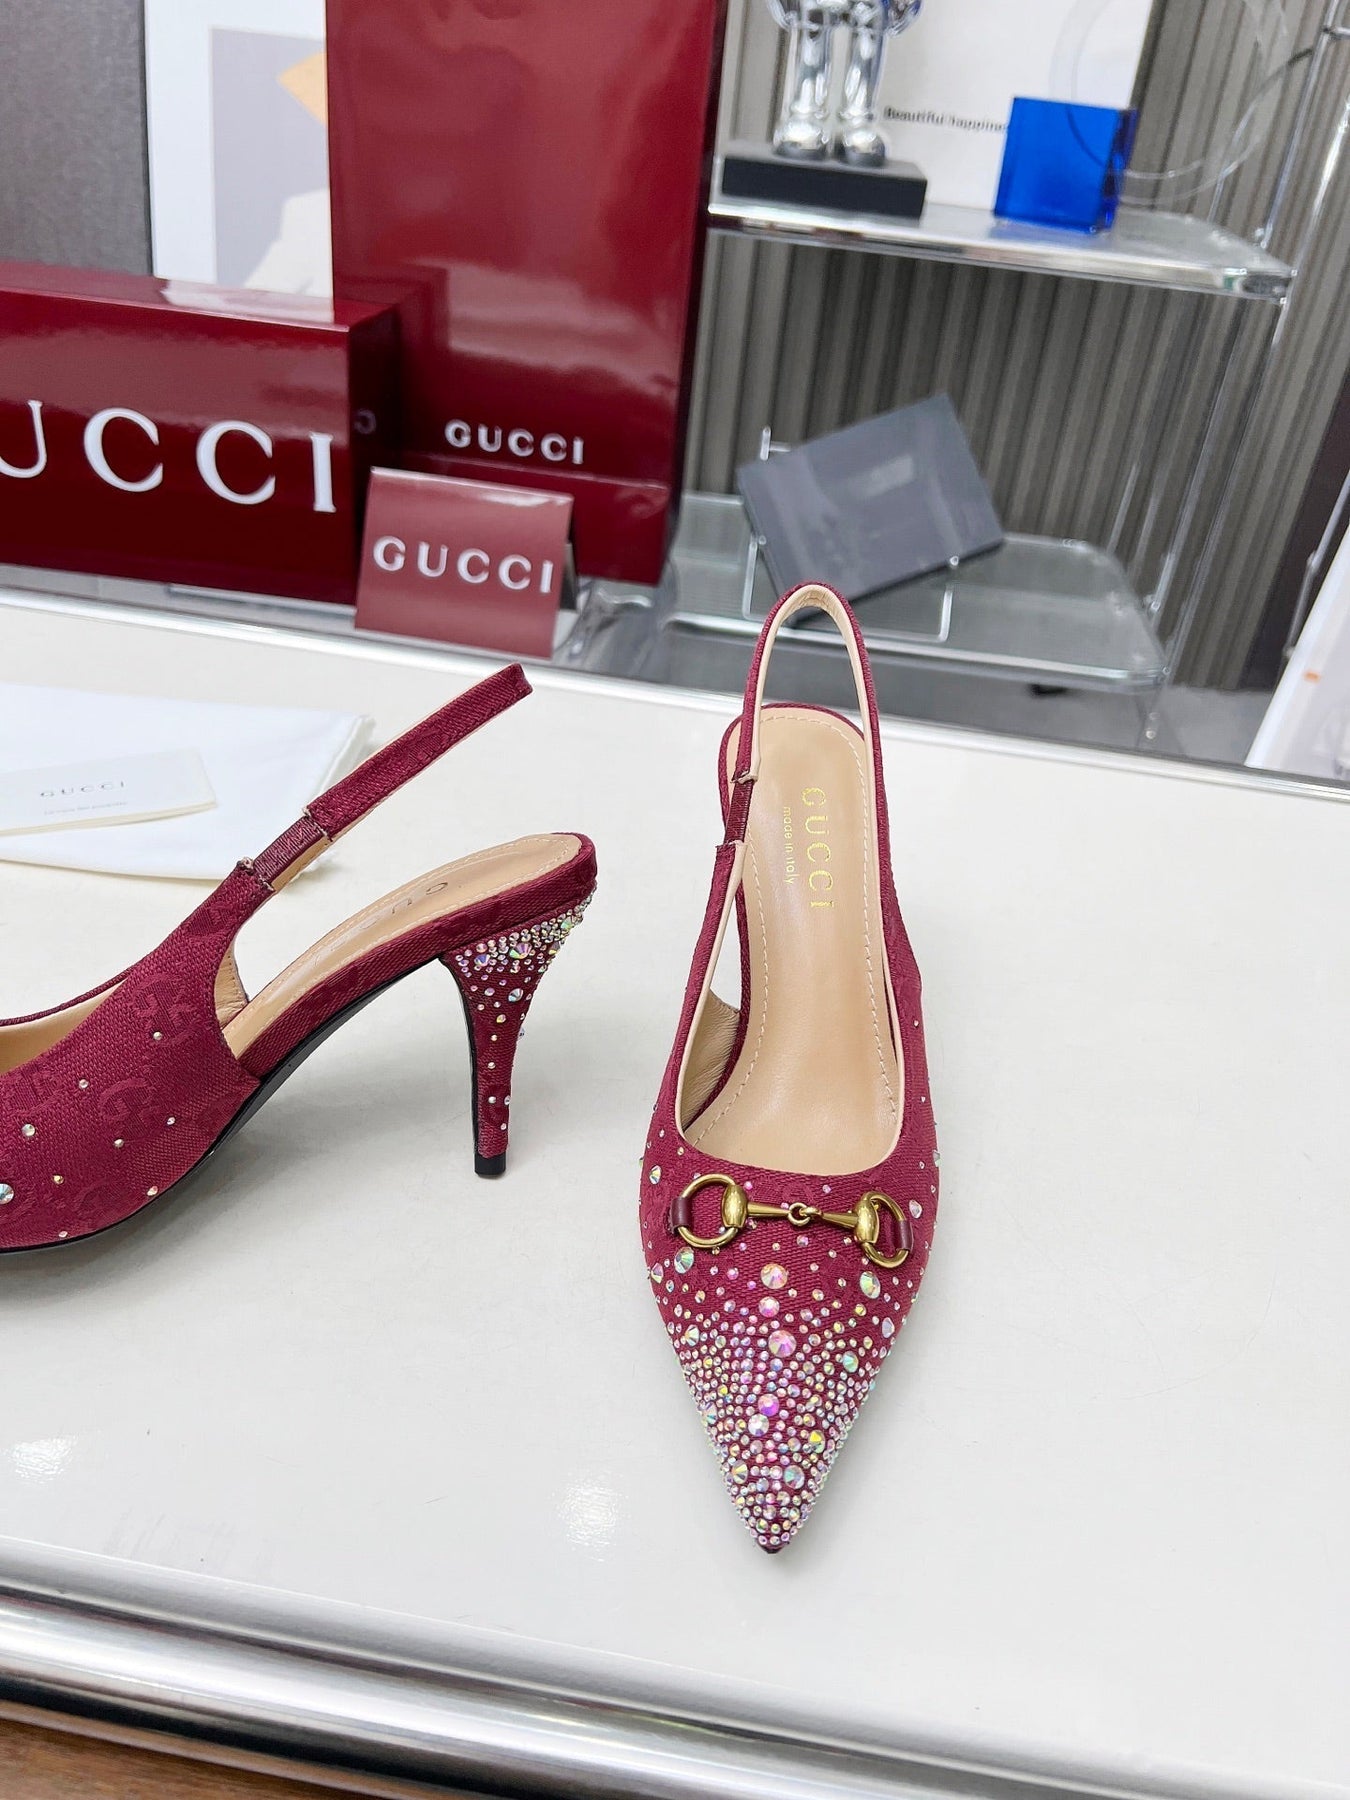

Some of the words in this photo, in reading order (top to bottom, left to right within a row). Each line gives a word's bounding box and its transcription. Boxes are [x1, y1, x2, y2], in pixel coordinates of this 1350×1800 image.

[444, 418, 585, 465] GUCCI
[372, 535, 554, 594] GUCCI
[783, 806, 793, 839] made
[784, 842, 794, 853] in
[801, 786, 835, 909] GUCCI
